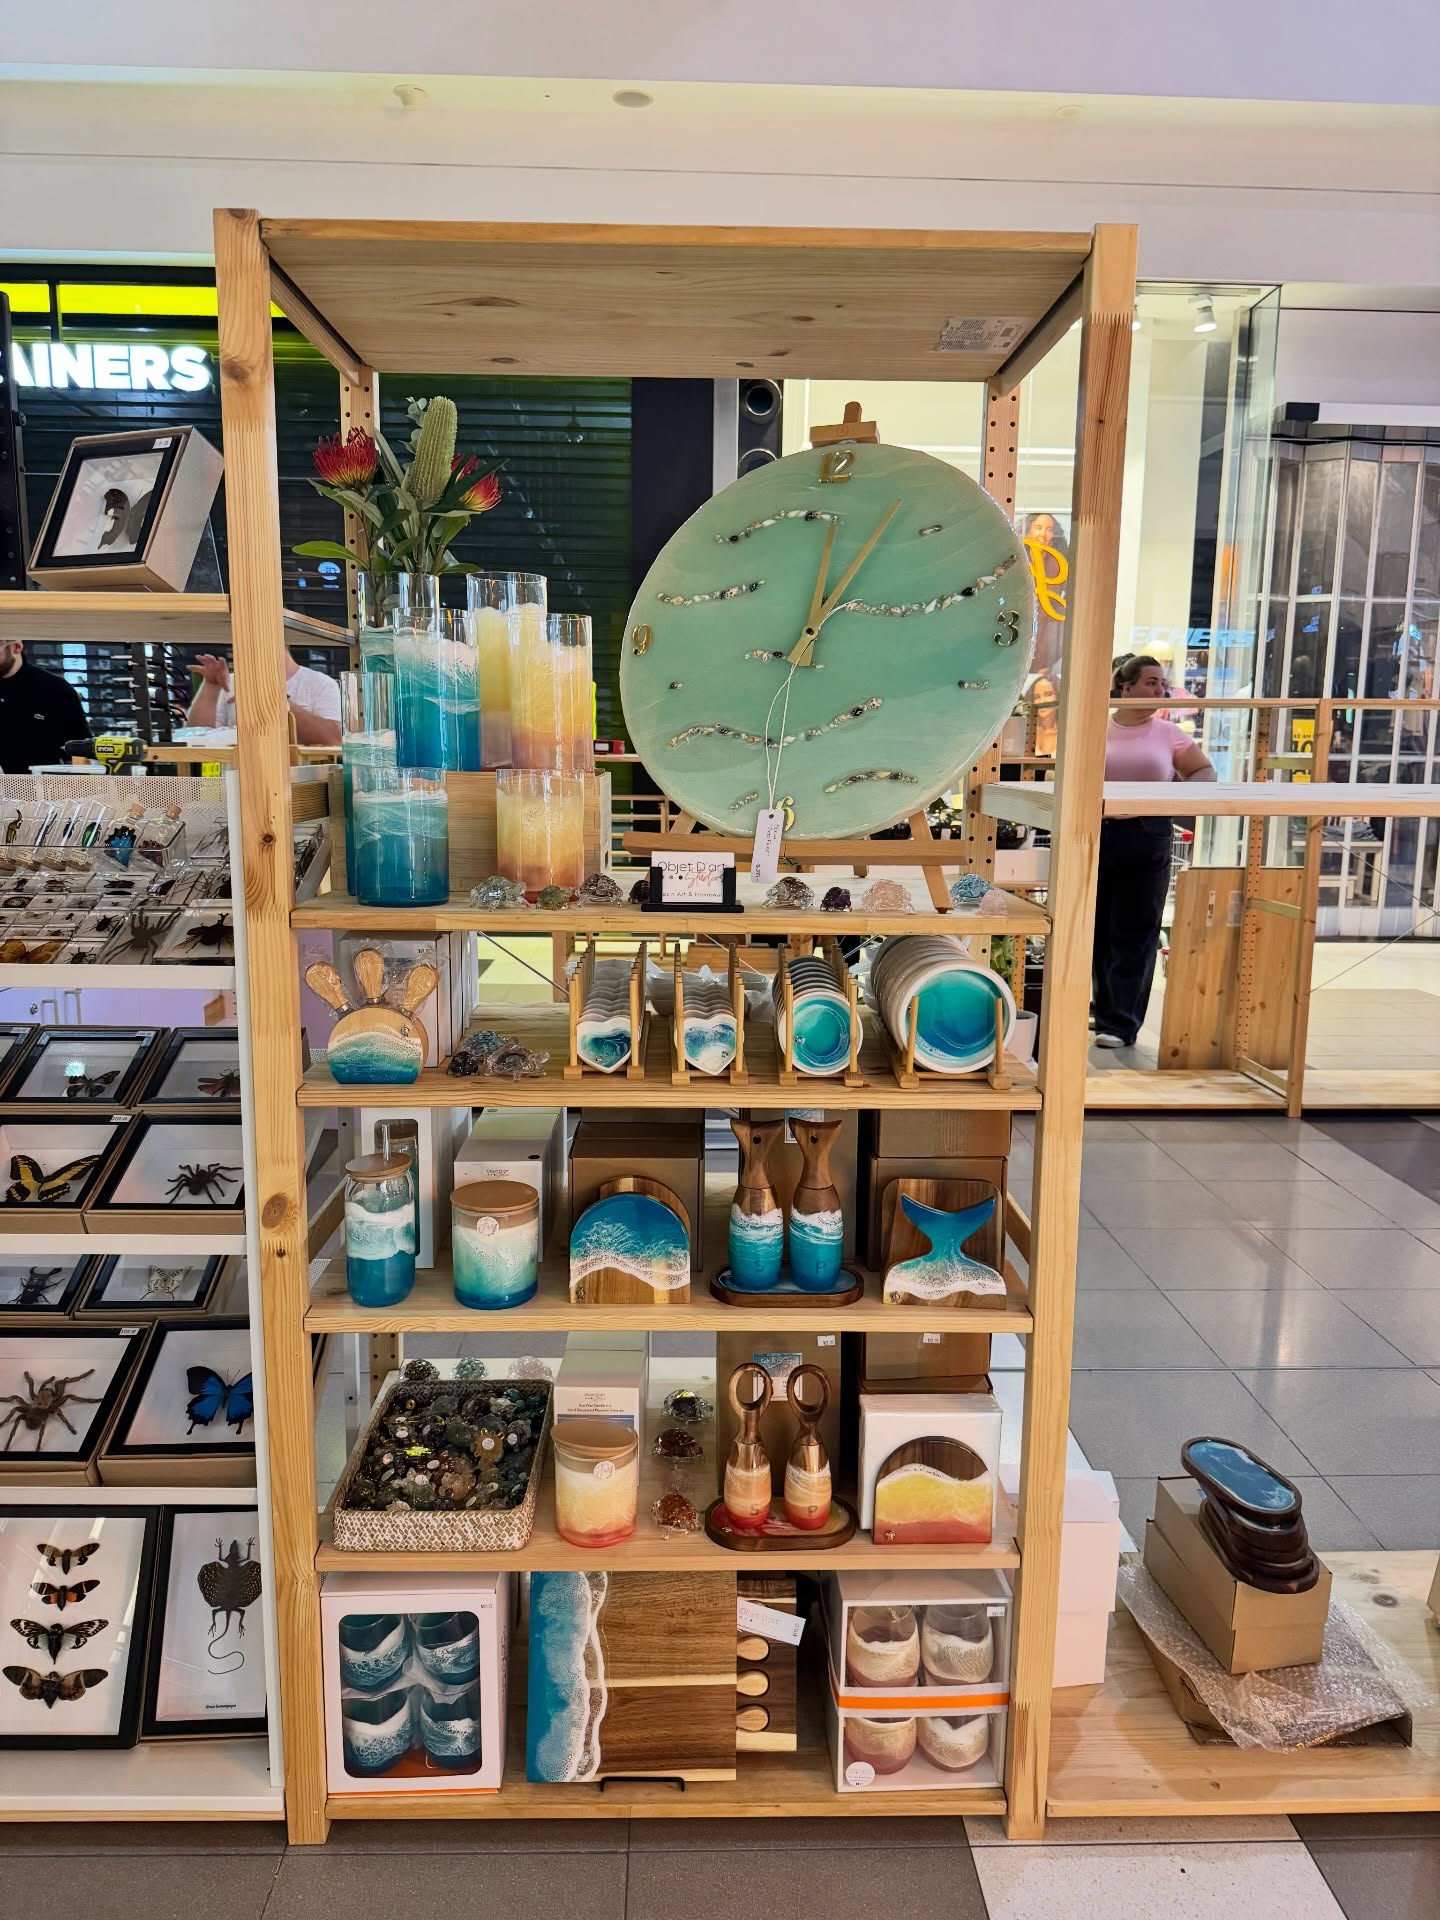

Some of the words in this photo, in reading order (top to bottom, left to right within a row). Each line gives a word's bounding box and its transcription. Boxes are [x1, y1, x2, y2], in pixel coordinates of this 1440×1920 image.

[818, 449, 855, 484] 12
[631, 623, 652, 657] 9
[993, 610, 1020, 647] 3
[657, 861, 693, 875] Objet
